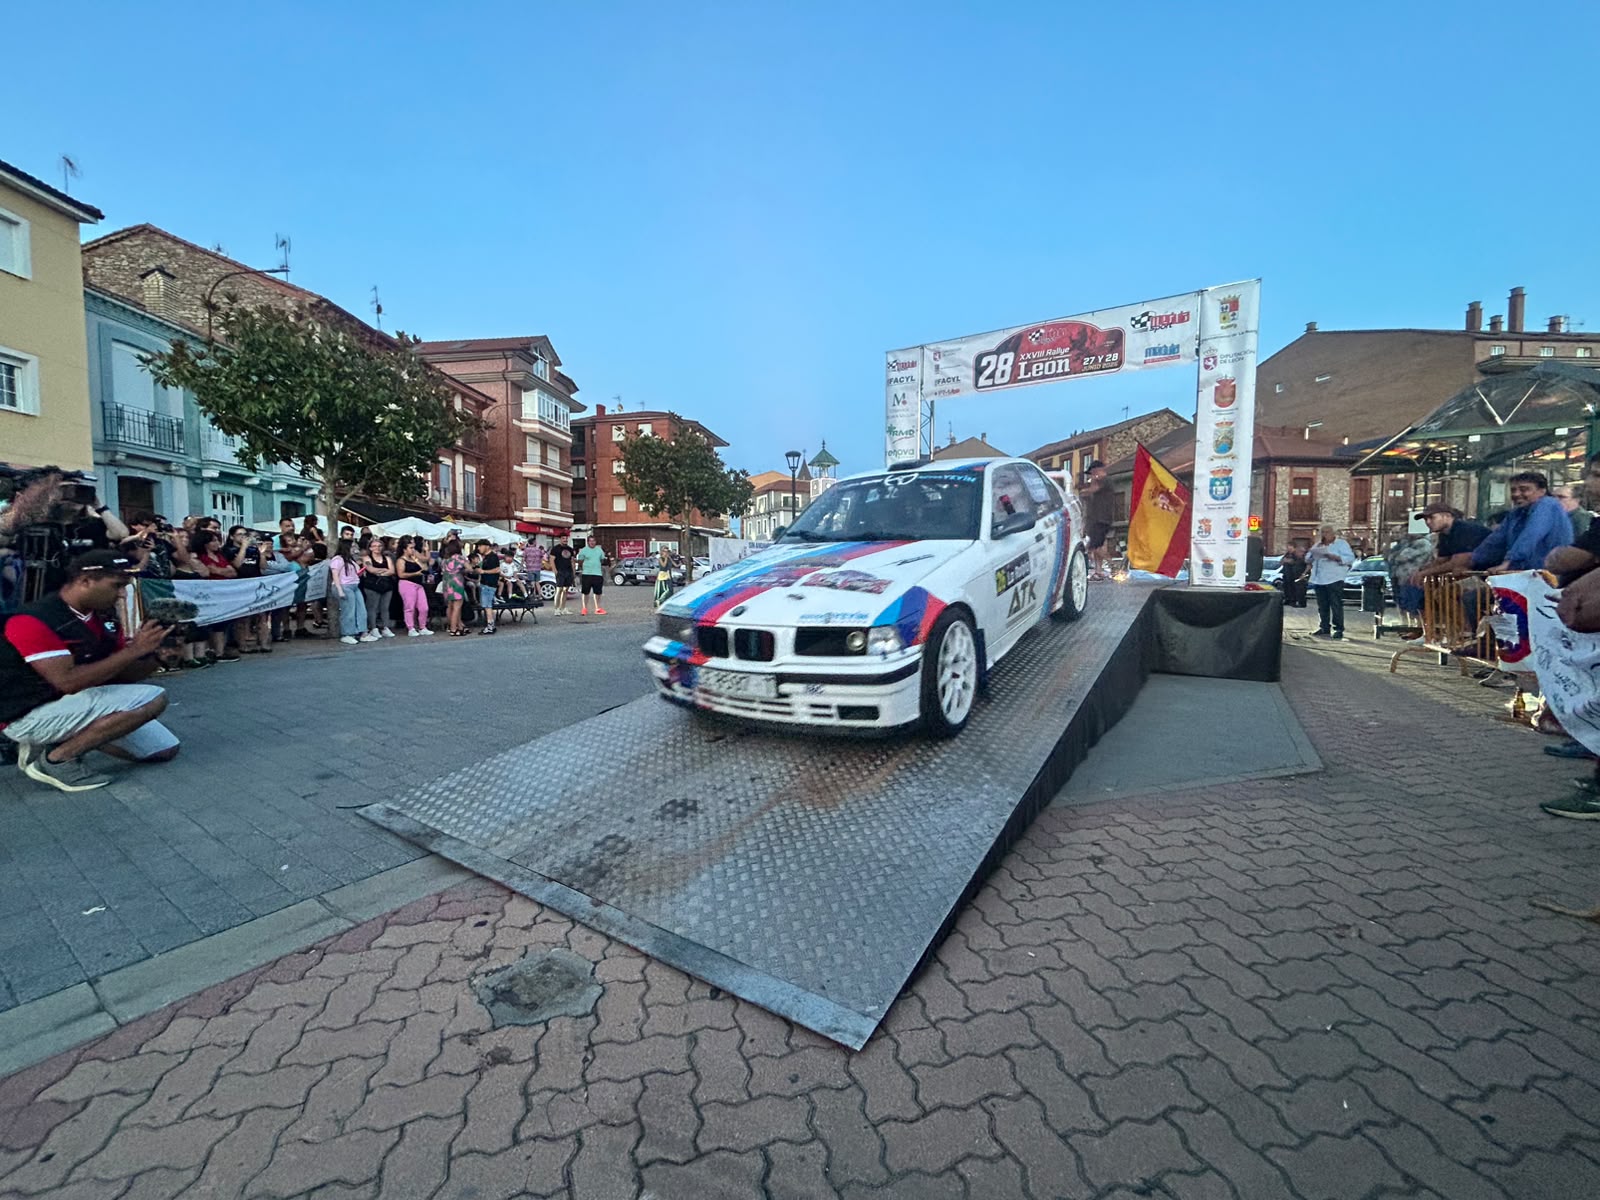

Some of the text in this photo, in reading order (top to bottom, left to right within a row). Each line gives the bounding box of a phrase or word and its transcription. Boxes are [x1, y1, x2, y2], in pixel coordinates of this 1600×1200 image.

[1019, 347, 1071, 361] XXVIII Rallye
[1083, 352, 1119, 366] 27 Y 28
[977, 351, 1015, 388] 28
[1017, 356, 1071, 379] León
[937, 375, 961, 385] FACYL
